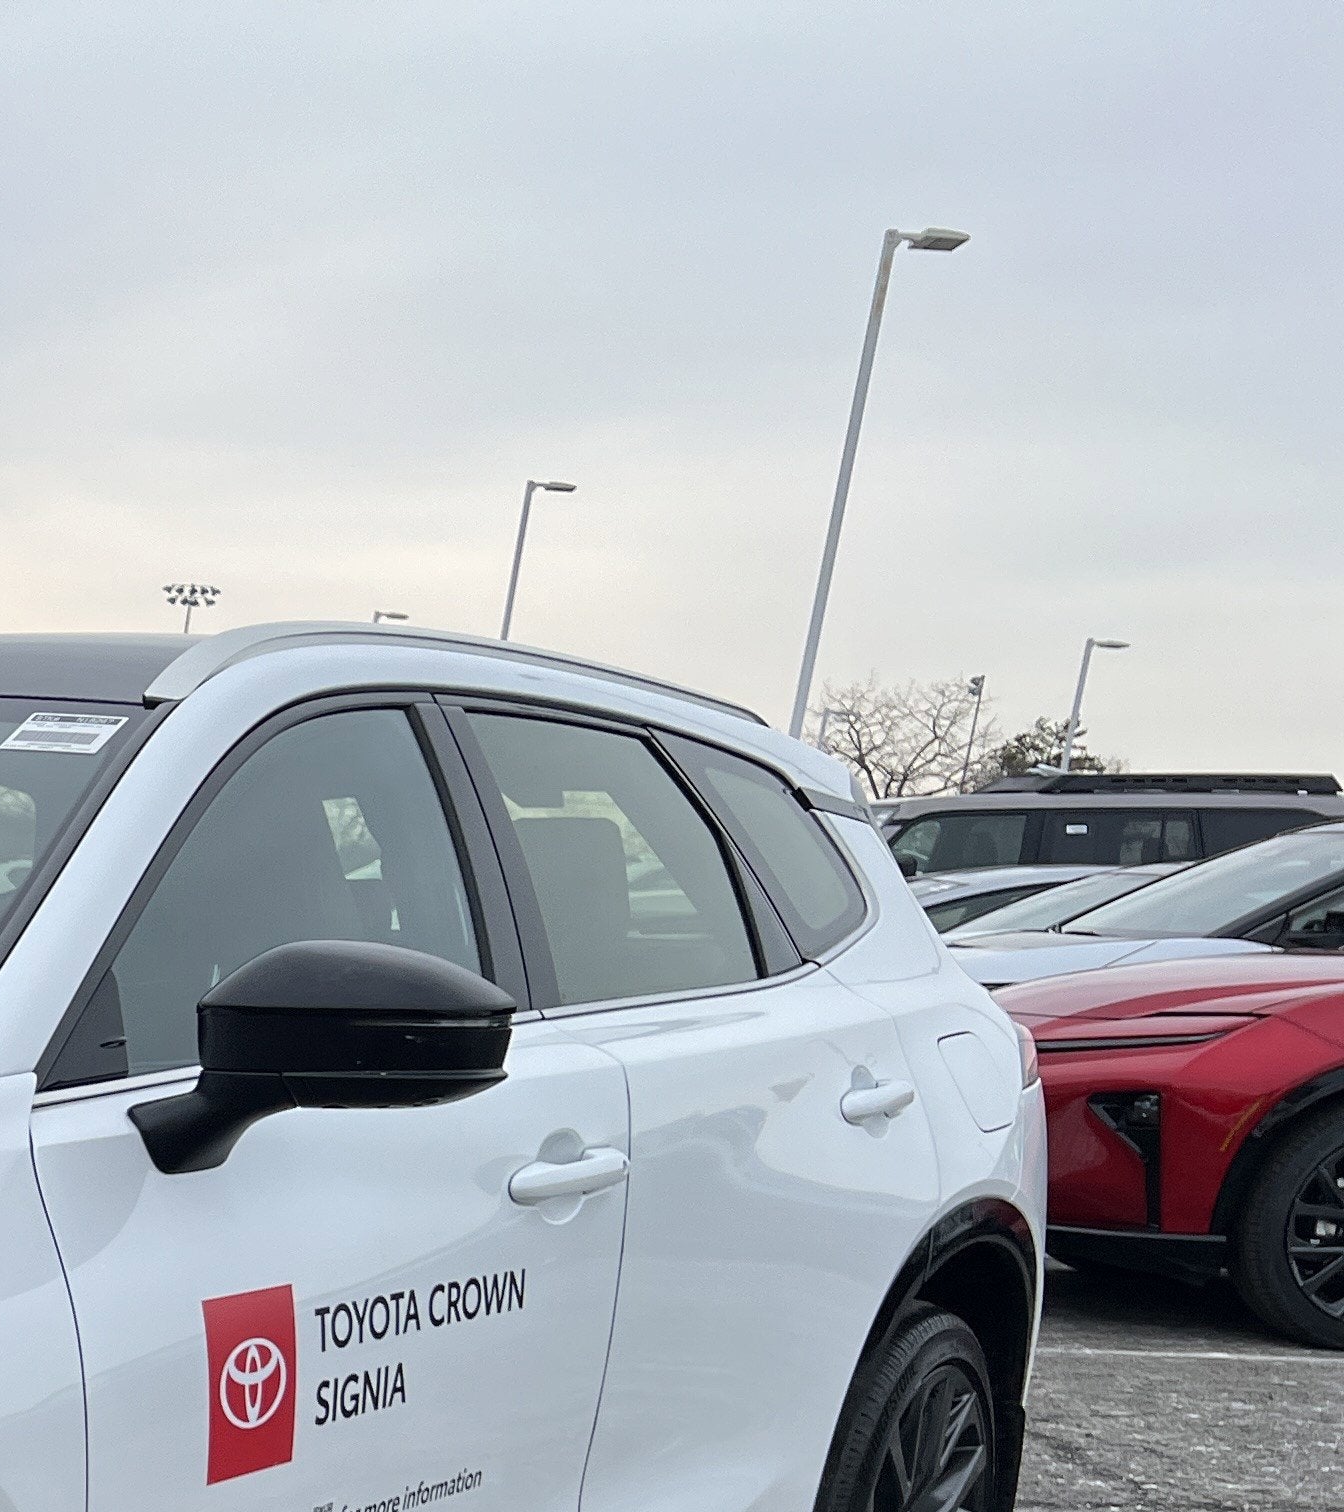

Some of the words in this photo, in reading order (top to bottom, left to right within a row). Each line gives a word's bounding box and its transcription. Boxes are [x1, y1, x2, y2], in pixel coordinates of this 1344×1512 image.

[314, 1288, 422, 1352] TOYOTA
[428, 1268, 526, 1328] CROWN
[314, 1362, 407, 1426] SIGNIA
[401, 1467, 483, 1511] information
